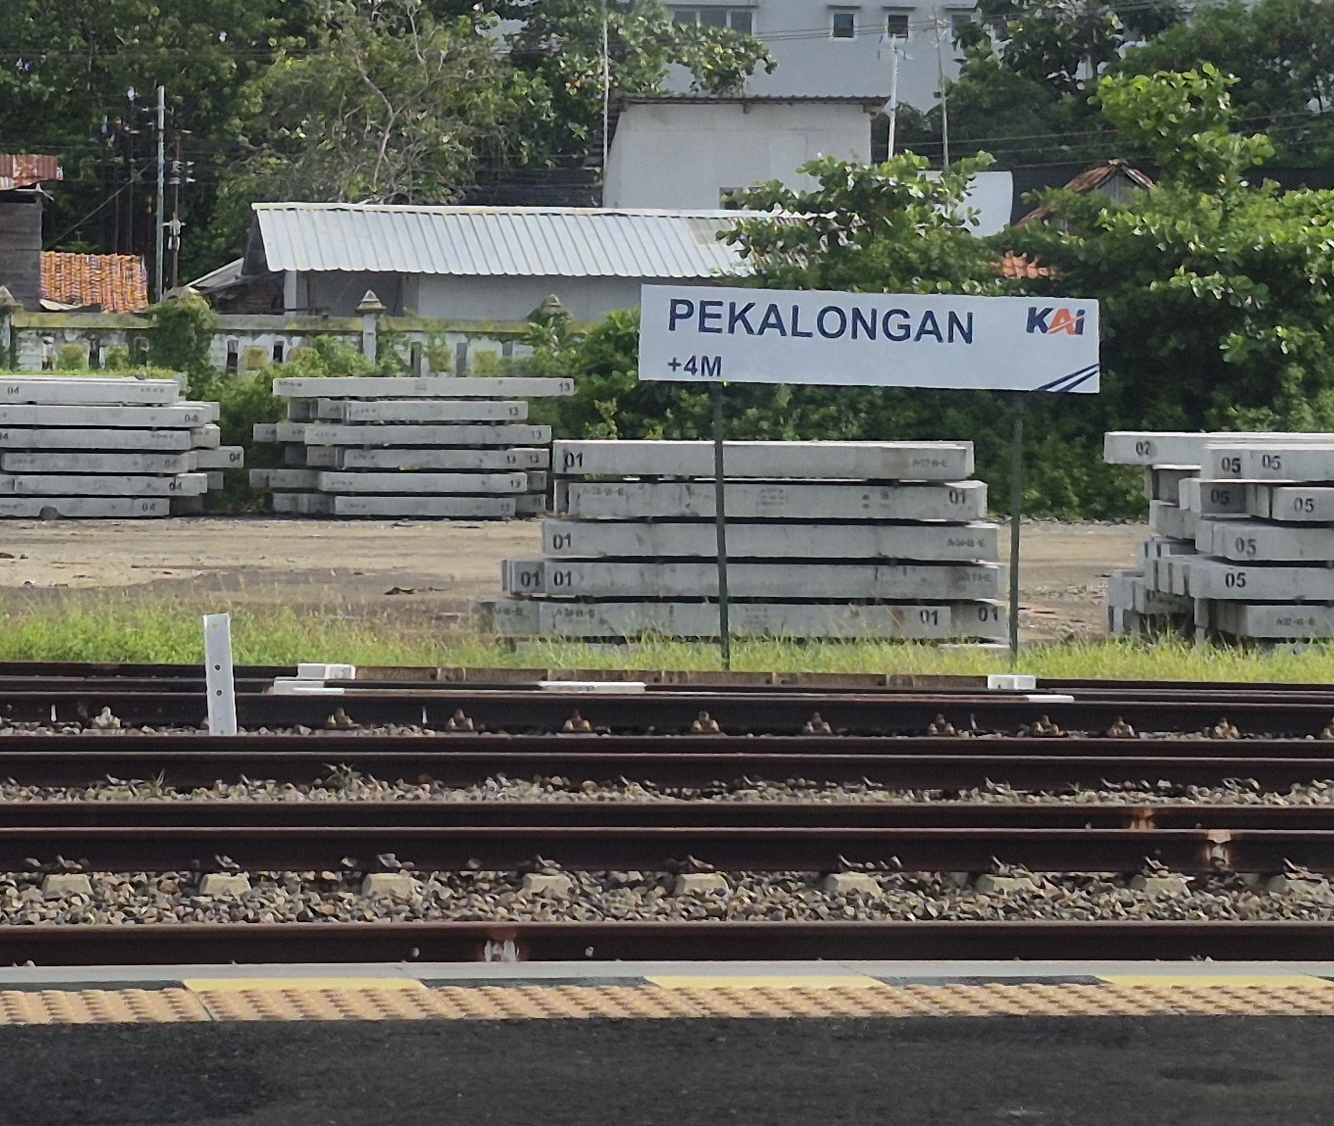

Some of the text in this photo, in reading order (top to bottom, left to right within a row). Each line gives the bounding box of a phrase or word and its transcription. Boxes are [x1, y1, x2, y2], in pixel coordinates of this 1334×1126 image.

[668, 298, 974, 345] PEKALONGAN
[667, 354, 722, 377] +4M
[564, 451, 584, 469] 01
[1221, 456, 1242, 474] 05
[1261, 454, 1282, 471] 05
[948, 487, 967, 505] 01
[1294, 497, 1315, 513] 05
[553, 532, 572, 550] 01
[1235, 536, 1257, 556] 05
[520, 570, 541, 588] 01
[553, 570, 573, 587] 01
[1225, 571, 1247, 588] 05
[919, 609, 939, 626] 01
[978, 606, 999, 623] 01
